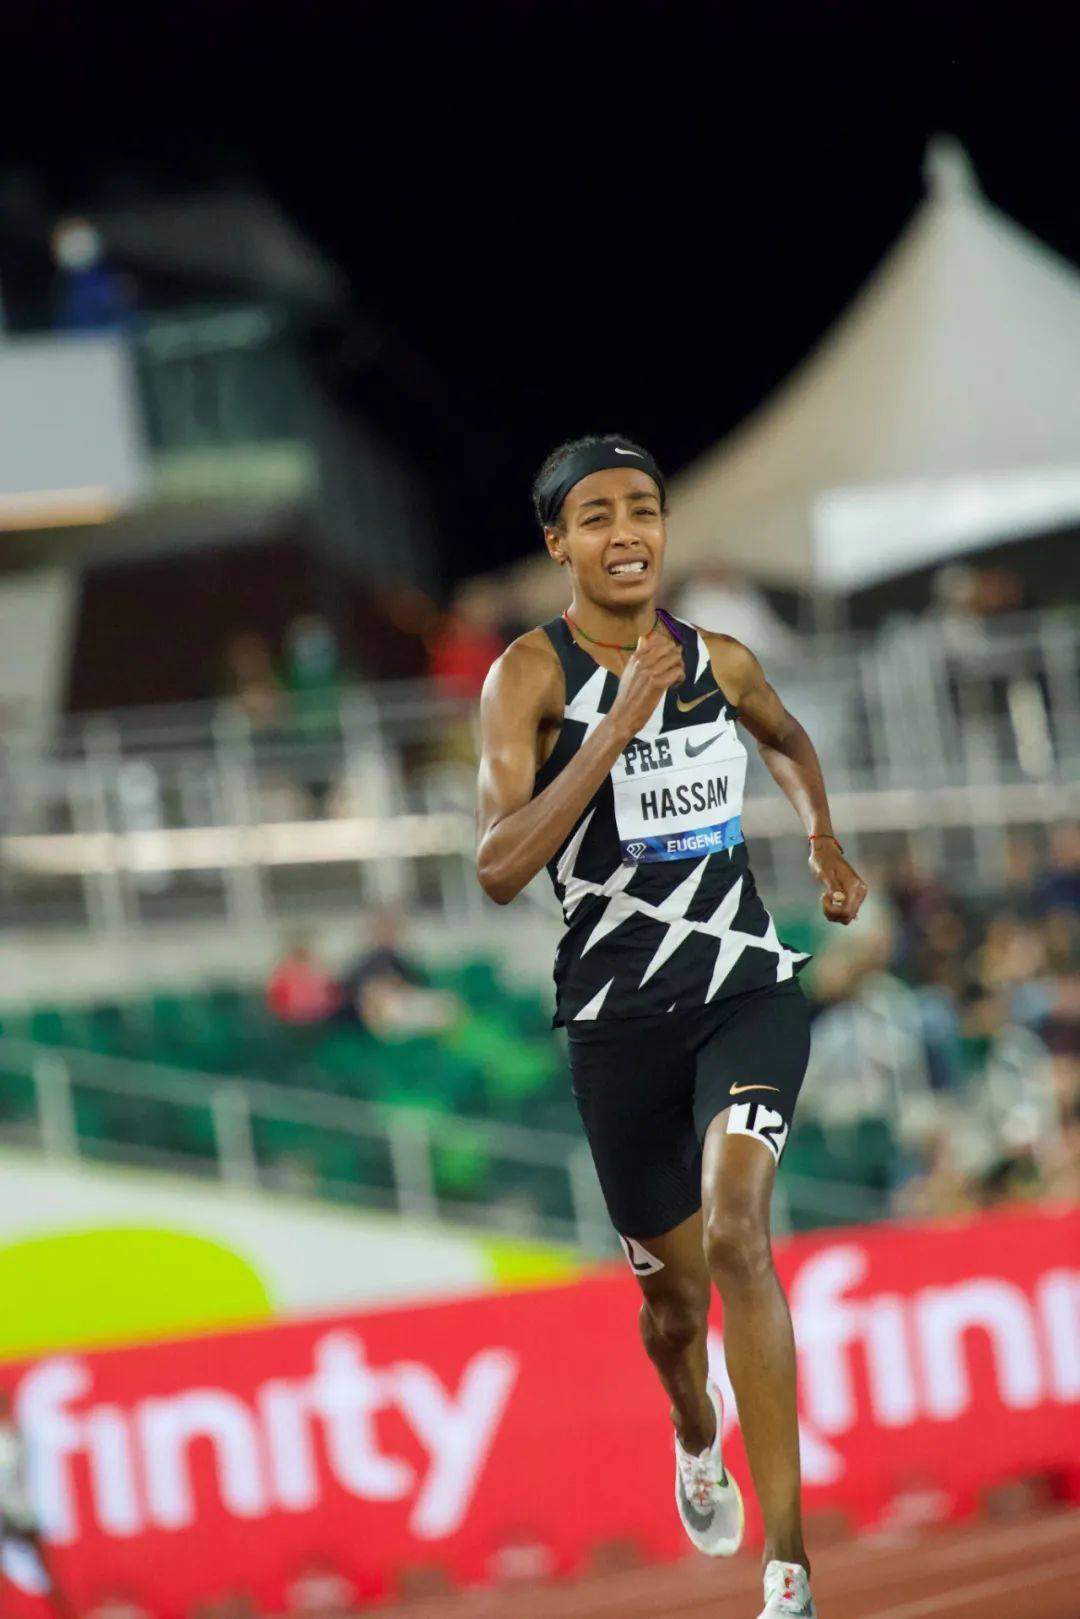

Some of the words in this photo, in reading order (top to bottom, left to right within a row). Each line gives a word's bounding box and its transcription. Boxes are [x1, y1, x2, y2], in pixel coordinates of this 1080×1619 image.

[622, 736, 674, 776] PRE
[640, 775, 729, 821] HASSAN
[666, 830, 723, 853] EUGENE
[3, 1330, 519, 1597] finity
